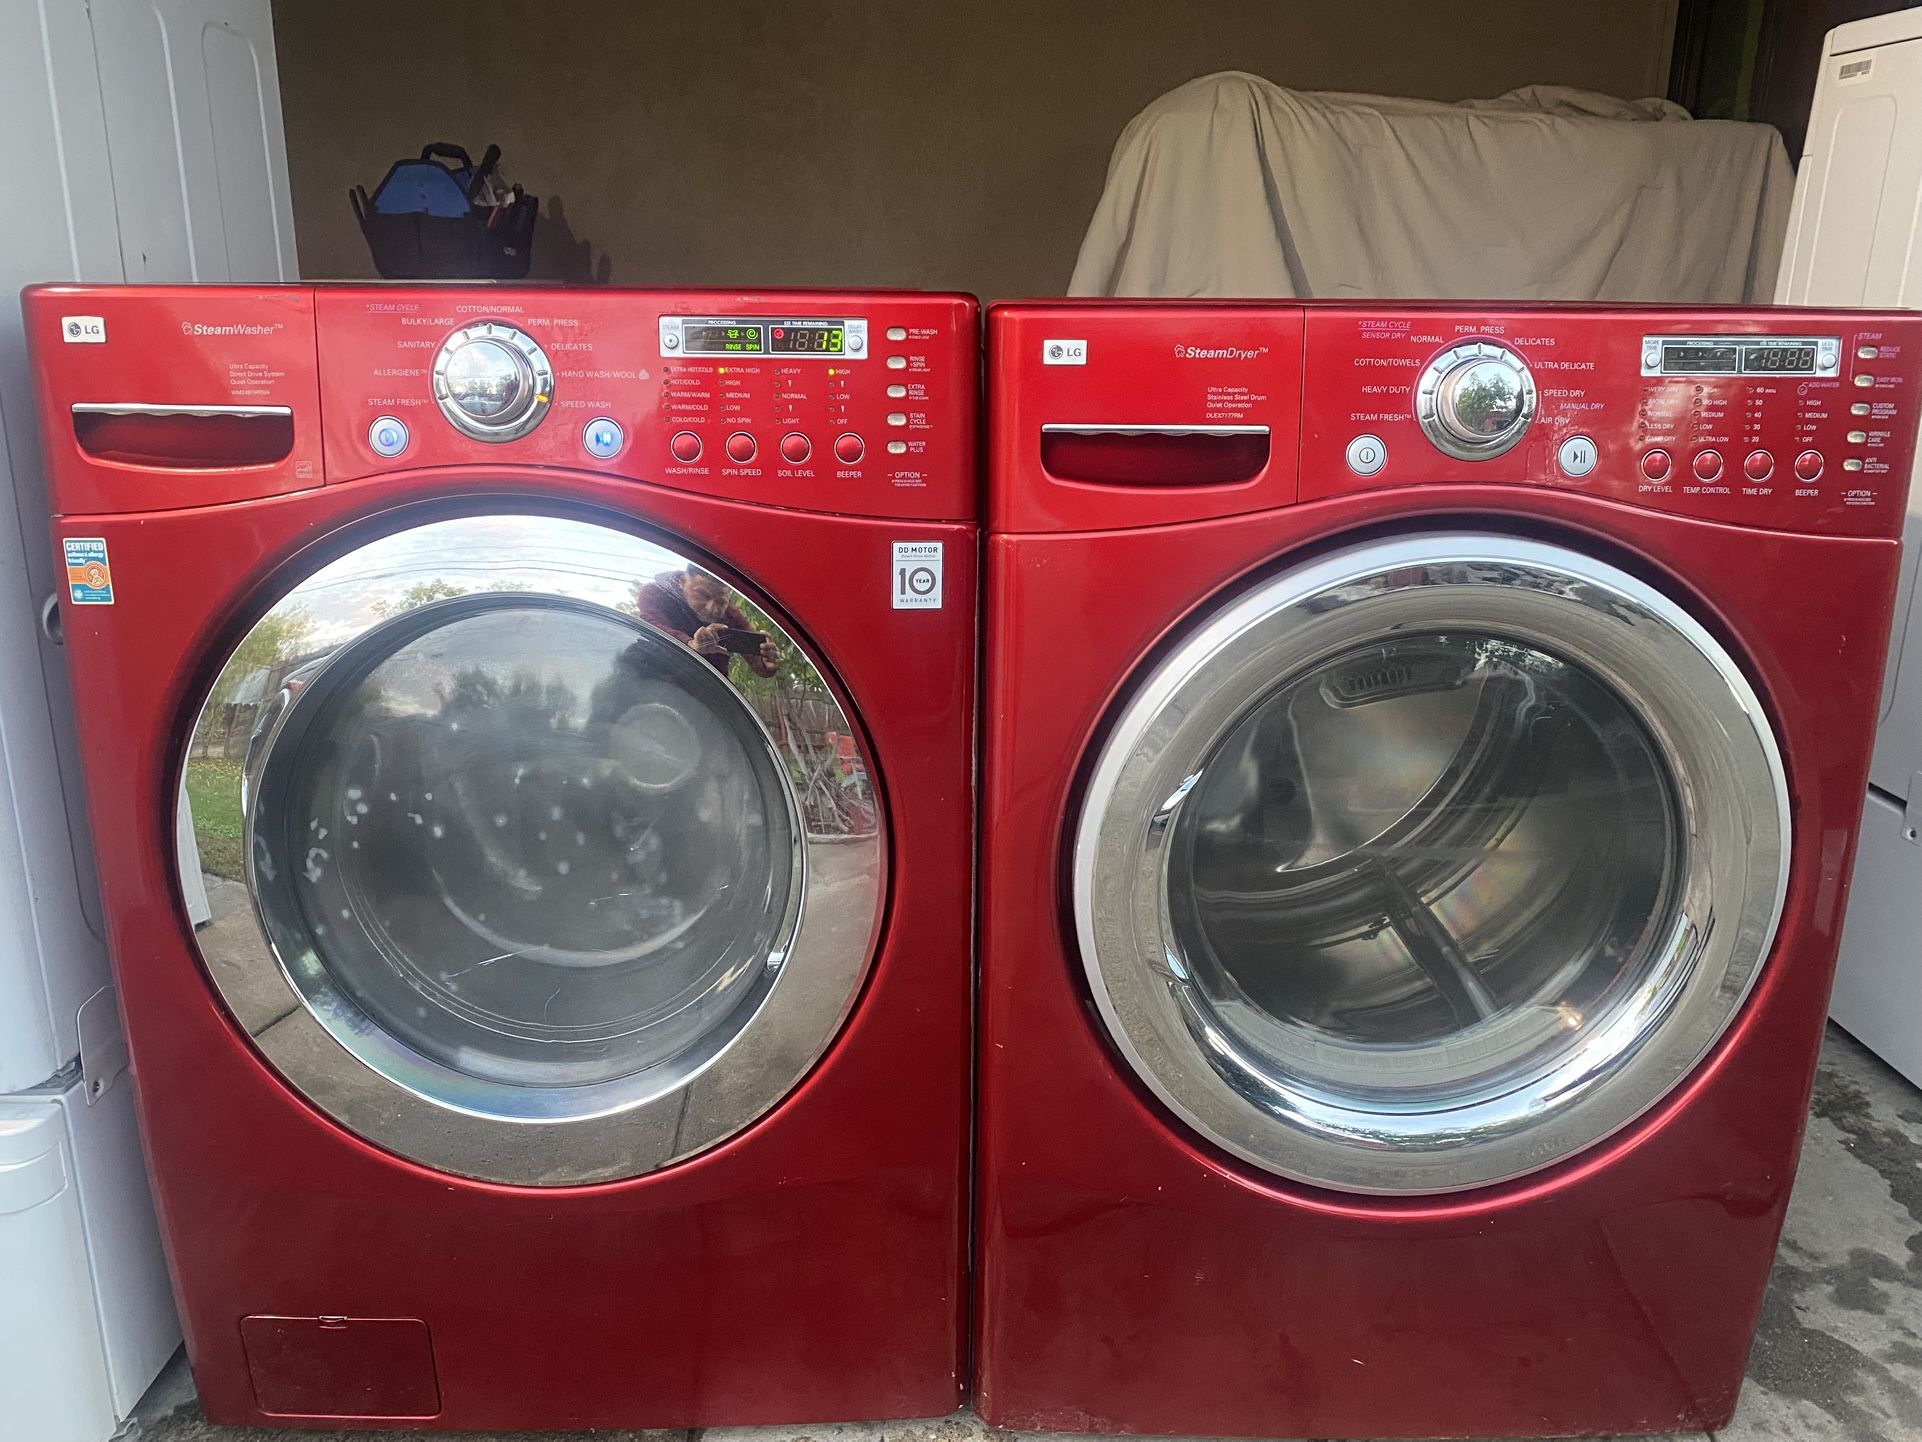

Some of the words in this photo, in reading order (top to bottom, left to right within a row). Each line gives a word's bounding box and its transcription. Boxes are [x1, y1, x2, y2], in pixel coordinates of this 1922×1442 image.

[396, 303, 420, 311] CYCLE
[456, 305, 524, 314] COTTON/NORMAL
[401, 318, 455, 326] BULKY/LARGE
[554, 319, 578, 327] PRESS
[1388, 321, 1411, 329] CYCLE
[84, 325, 100, 335] LG
[1480, 326, 1505, 334] PRESS
[1410, 336, 1444, 344] NORMAL
[1514, 338, 1556, 346] DELICATES
[551, 343, 592, 351] DELICATES
[1067, 348, 1081, 357] LG
[1354, 359, 1420, 367] COTTON/TOWELS
[1560, 362, 1595, 370] DELICATE
[1362, 386, 1389, 394] HEAVY
[1390, 386, 1410, 394] DUTY
[1544, 389, 1565, 397] SPEED
[368, 398, 395, 406] STEAM
[585, 401, 612, 409] WASH
[665, 466, 710, 474] WASH/RINSE
[722, 468, 738, 476] SPIN
[836, 470, 862, 478] BEEPER
[66, 542, 104, 551] CERTIFIED
[899, 567, 936, 595] 10
